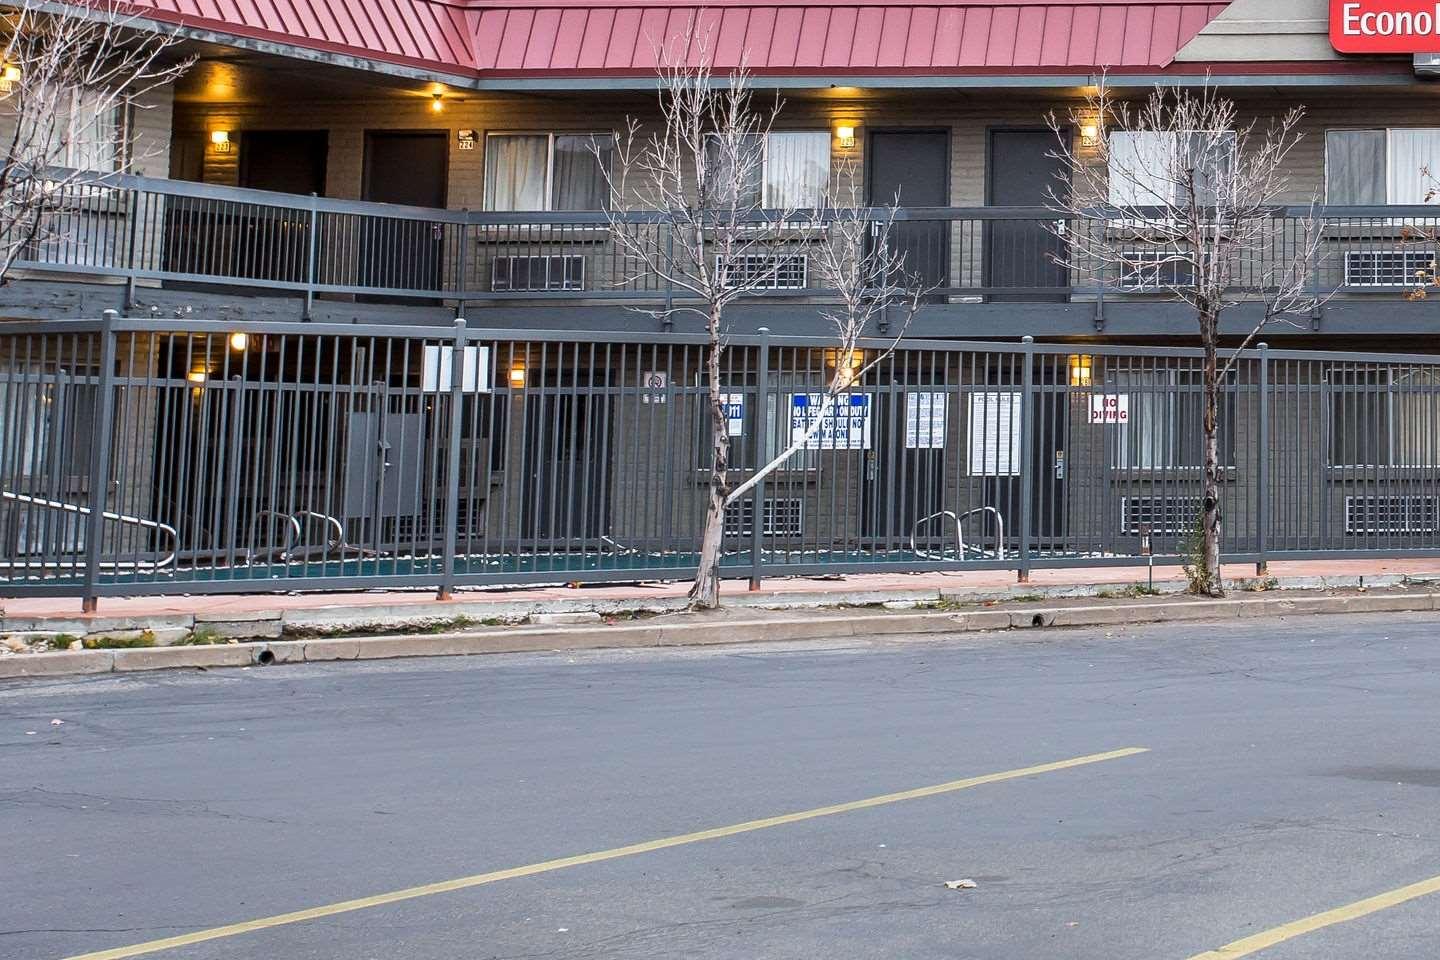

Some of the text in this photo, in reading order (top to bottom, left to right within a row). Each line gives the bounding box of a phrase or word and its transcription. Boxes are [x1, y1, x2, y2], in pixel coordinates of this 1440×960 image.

[810, 395, 849, 406] WNNG
[1104, 399, 1117, 407] NO
[802, 406, 838, 416] LFEGAR
[1092, 410, 1127, 419] DIVING
[793, 418, 821, 428] BATE
[852, 418, 866, 428] NO
[808, 430, 850, 438] SWM AON
